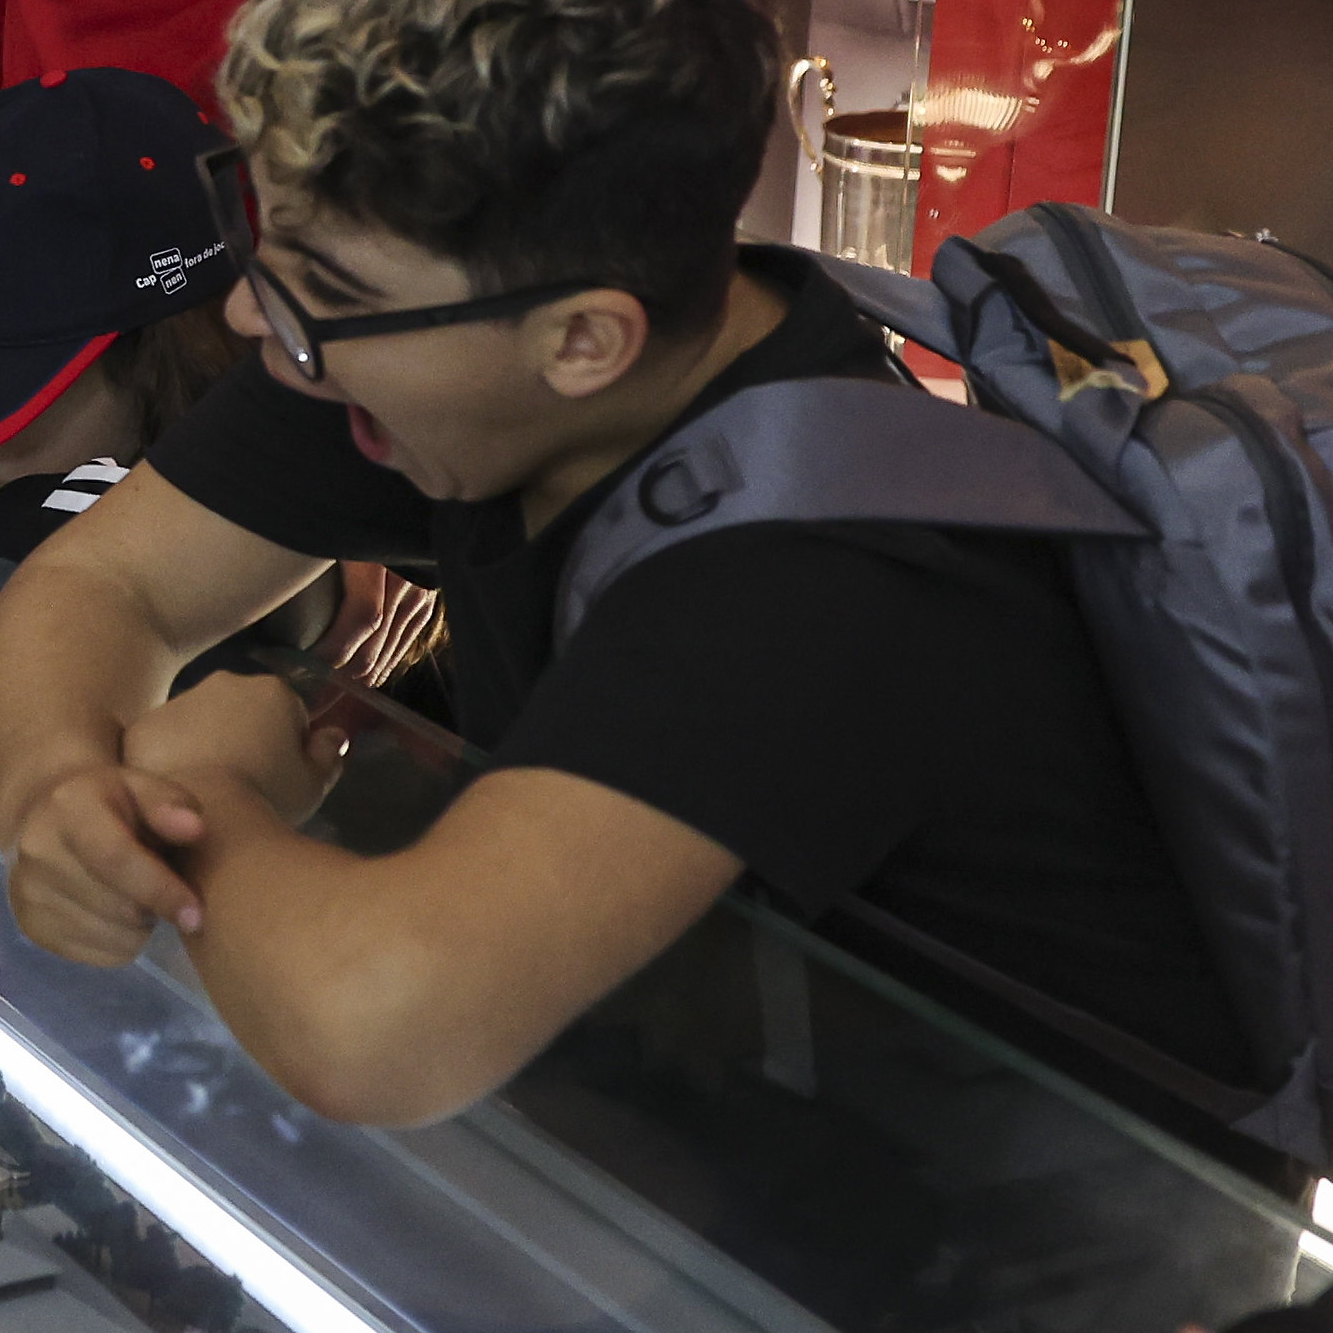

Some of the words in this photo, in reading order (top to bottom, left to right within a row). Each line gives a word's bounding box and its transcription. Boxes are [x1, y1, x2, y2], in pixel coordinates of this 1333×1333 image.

[136, 274, 157, 288] Cap
[153, 254, 180, 268] nena
[165, 272, 183, 289] nen
